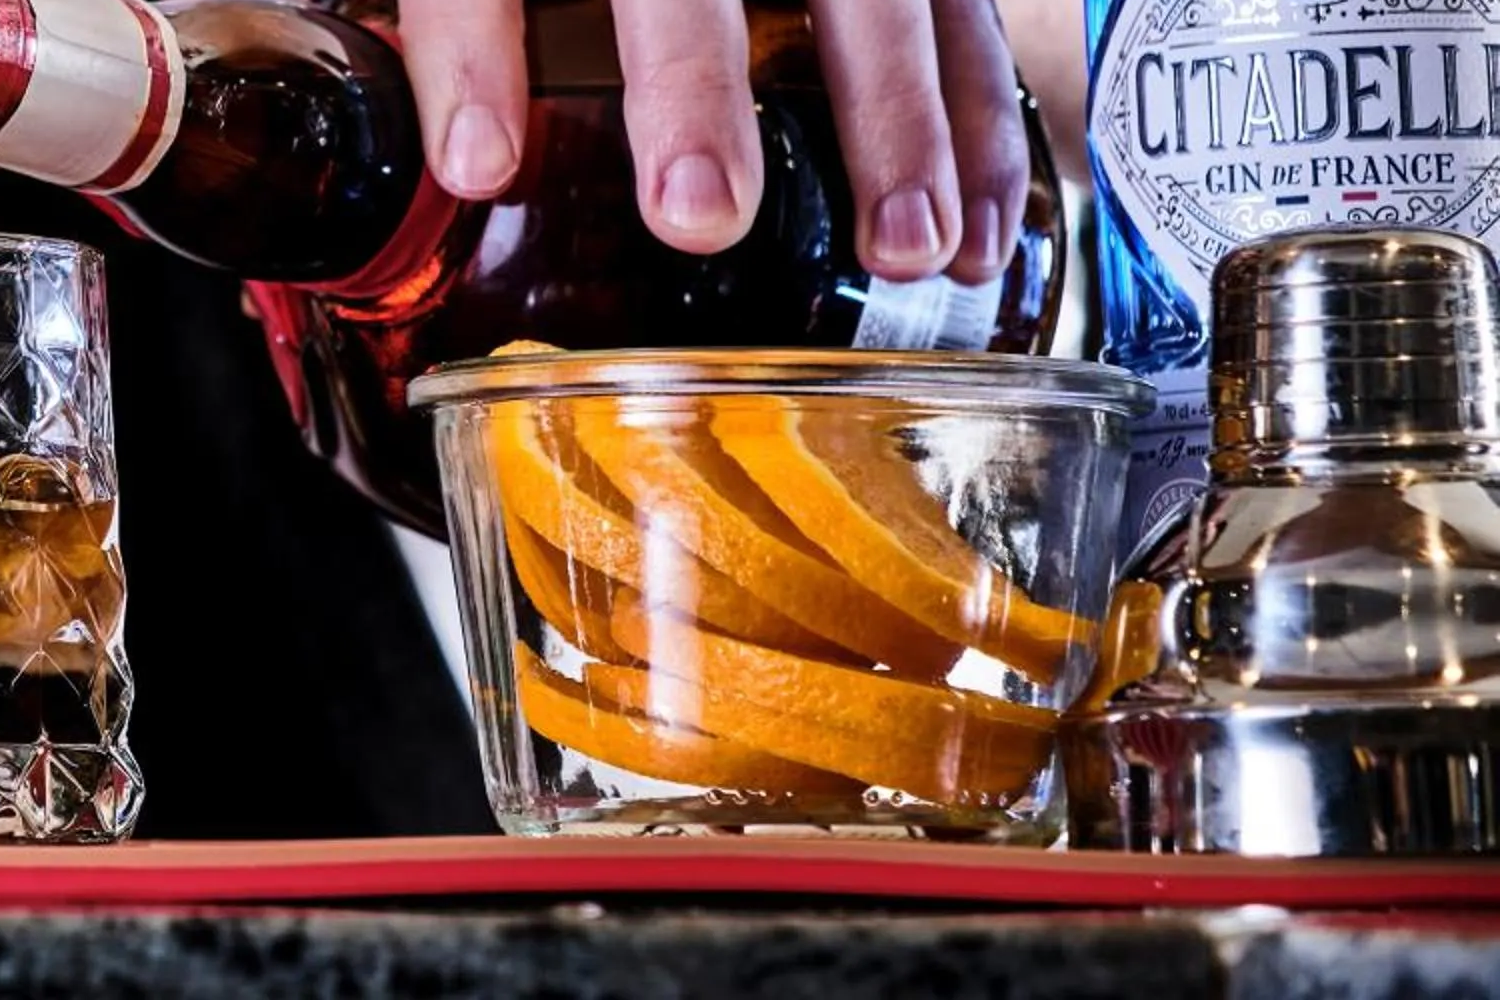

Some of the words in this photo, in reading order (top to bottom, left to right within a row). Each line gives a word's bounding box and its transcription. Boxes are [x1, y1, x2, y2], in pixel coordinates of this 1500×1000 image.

[1205, 162, 1261, 195] GIN
[1272, 163, 1302, 187] DE
[1311, 153, 1456, 188] FRANCE
